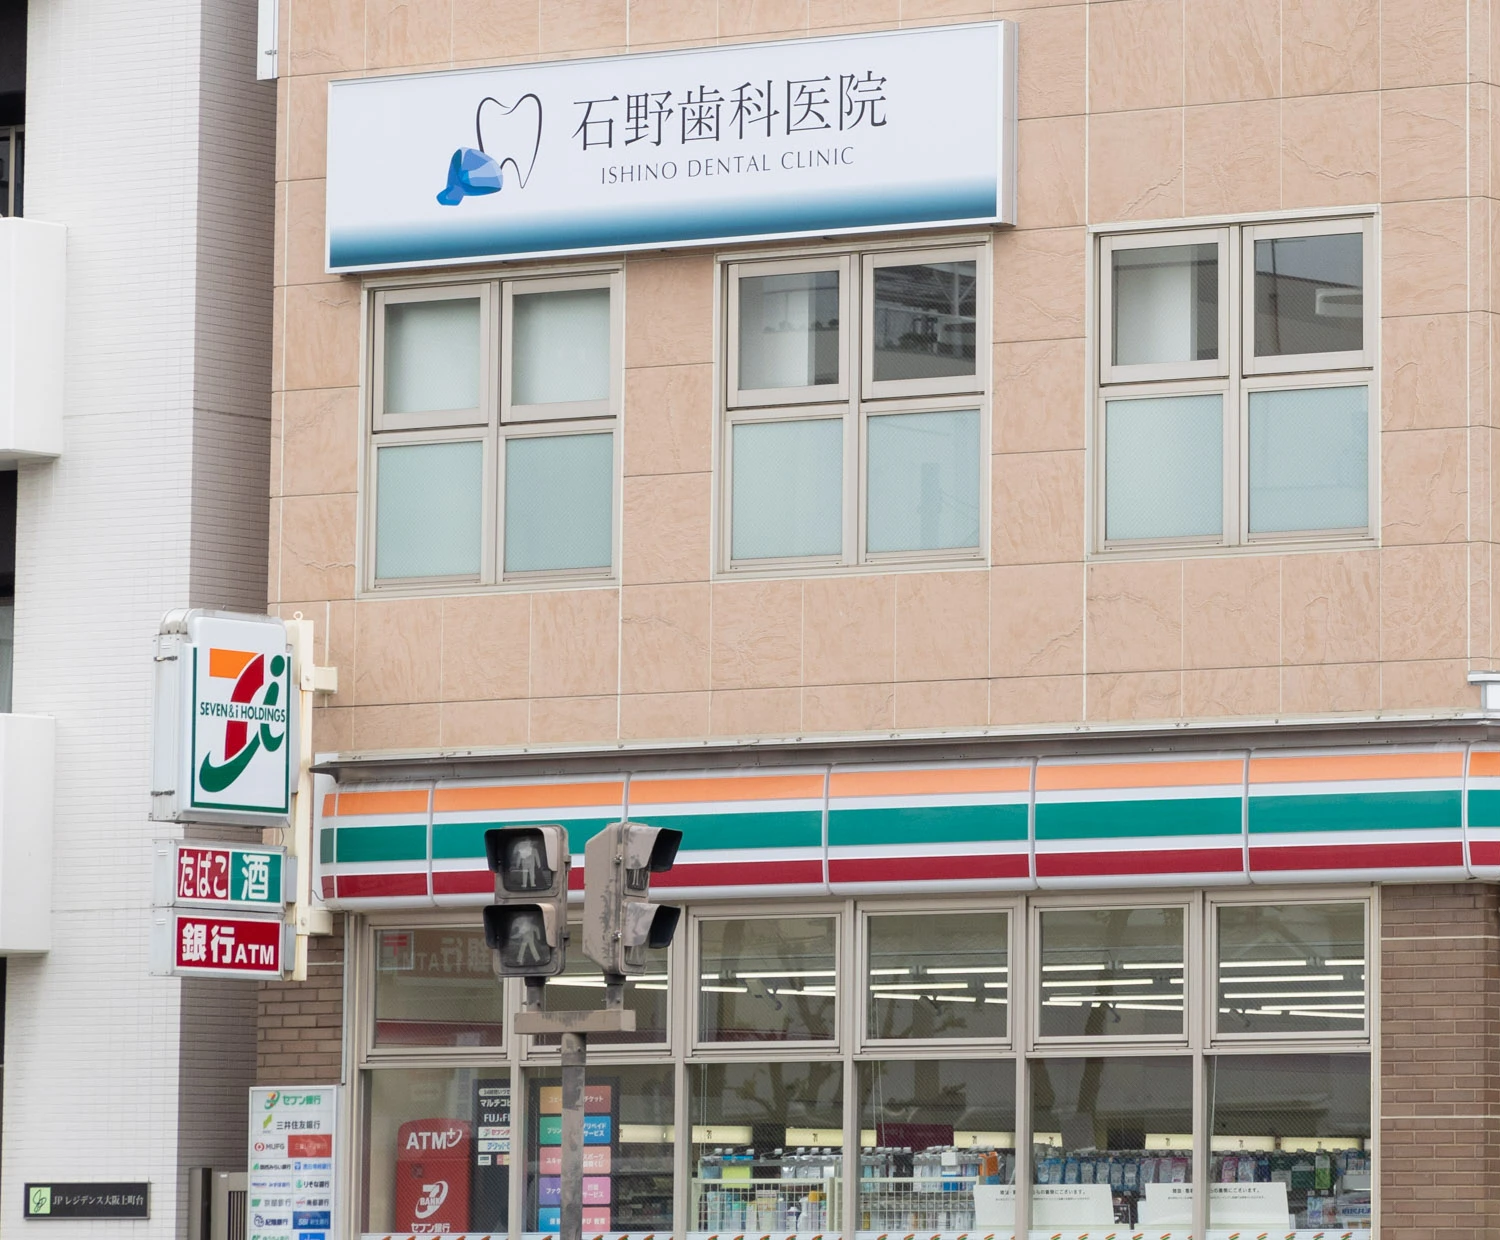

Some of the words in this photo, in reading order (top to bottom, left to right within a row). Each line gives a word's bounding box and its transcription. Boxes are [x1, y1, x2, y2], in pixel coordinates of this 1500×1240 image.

[571, 70, 888, 151] 石野歯科医院
[601, 161, 678, 185] ISHINO
[687, 153, 772, 178] DENTAL
[780, 146, 854, 170] CLINIC
[240, 705, 286, 723] HOLDINGS
[179, 851, 228, 899] たばこ
[241, 854, 271, 901] 酒
[181, 921, 275, 966] 銀行ATM
[283, 1094, 322, 1106] セブン銀行
[276, 1120, 321, 1130] 三井住友銀行
[52, 1195, 63, 1206] JP
[65, 1194, 144, 1206] レジデンス大阪上町台
[411, 1223, 450, 1233] セブン銀行
